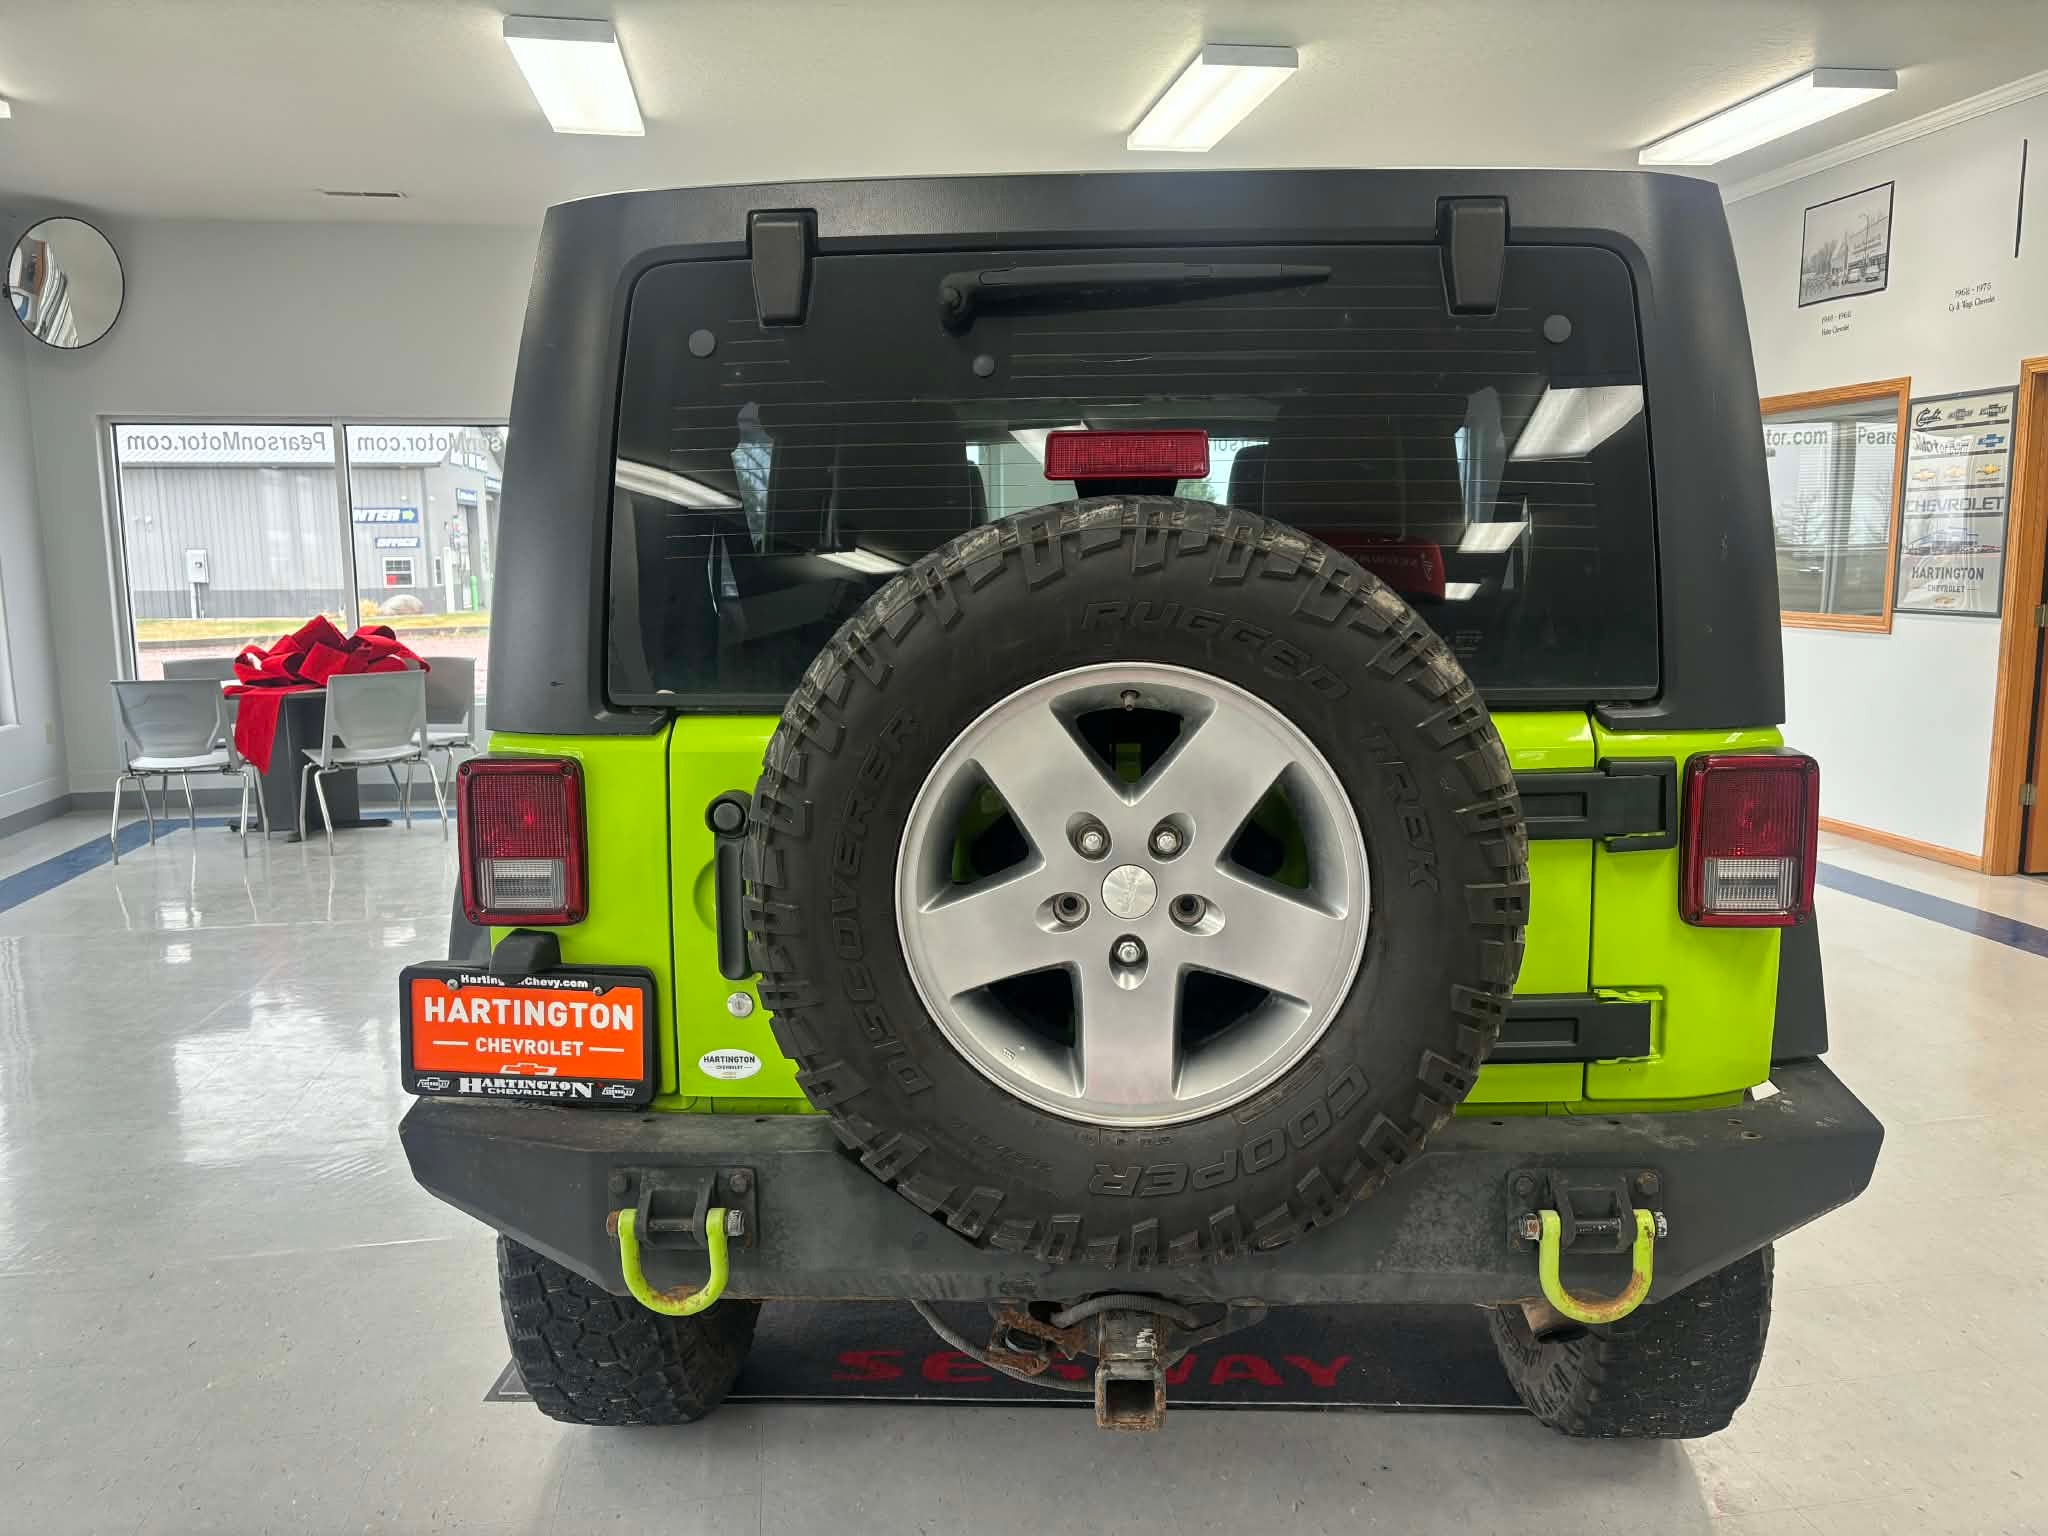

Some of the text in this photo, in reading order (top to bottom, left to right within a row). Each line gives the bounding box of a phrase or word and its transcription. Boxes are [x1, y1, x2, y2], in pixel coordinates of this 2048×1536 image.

[1765, 429, 1828, 446] tor.com
[1857, 426, 1897, 446] Pears
[1911, 566, 1985, 581] HARTINGTON
[1927, 584, 1965, 593] CHEVROLET
[1080, 600, 1351, 702] RUGGED
[460, 974, 589, 989] HartinChevy.com
[424, 996, 634, 1031] HARTINGTON
[475, 1037, 584, 1056] CHEVROLET
[703, 1055, 755, 1063] HARTINGTON
[458, 1077, 595, 1099] HARTINGTON
[487, 1087, 566, 1097] CHEVROLET
[1088, 1063, 1370, 1198] COOPER
